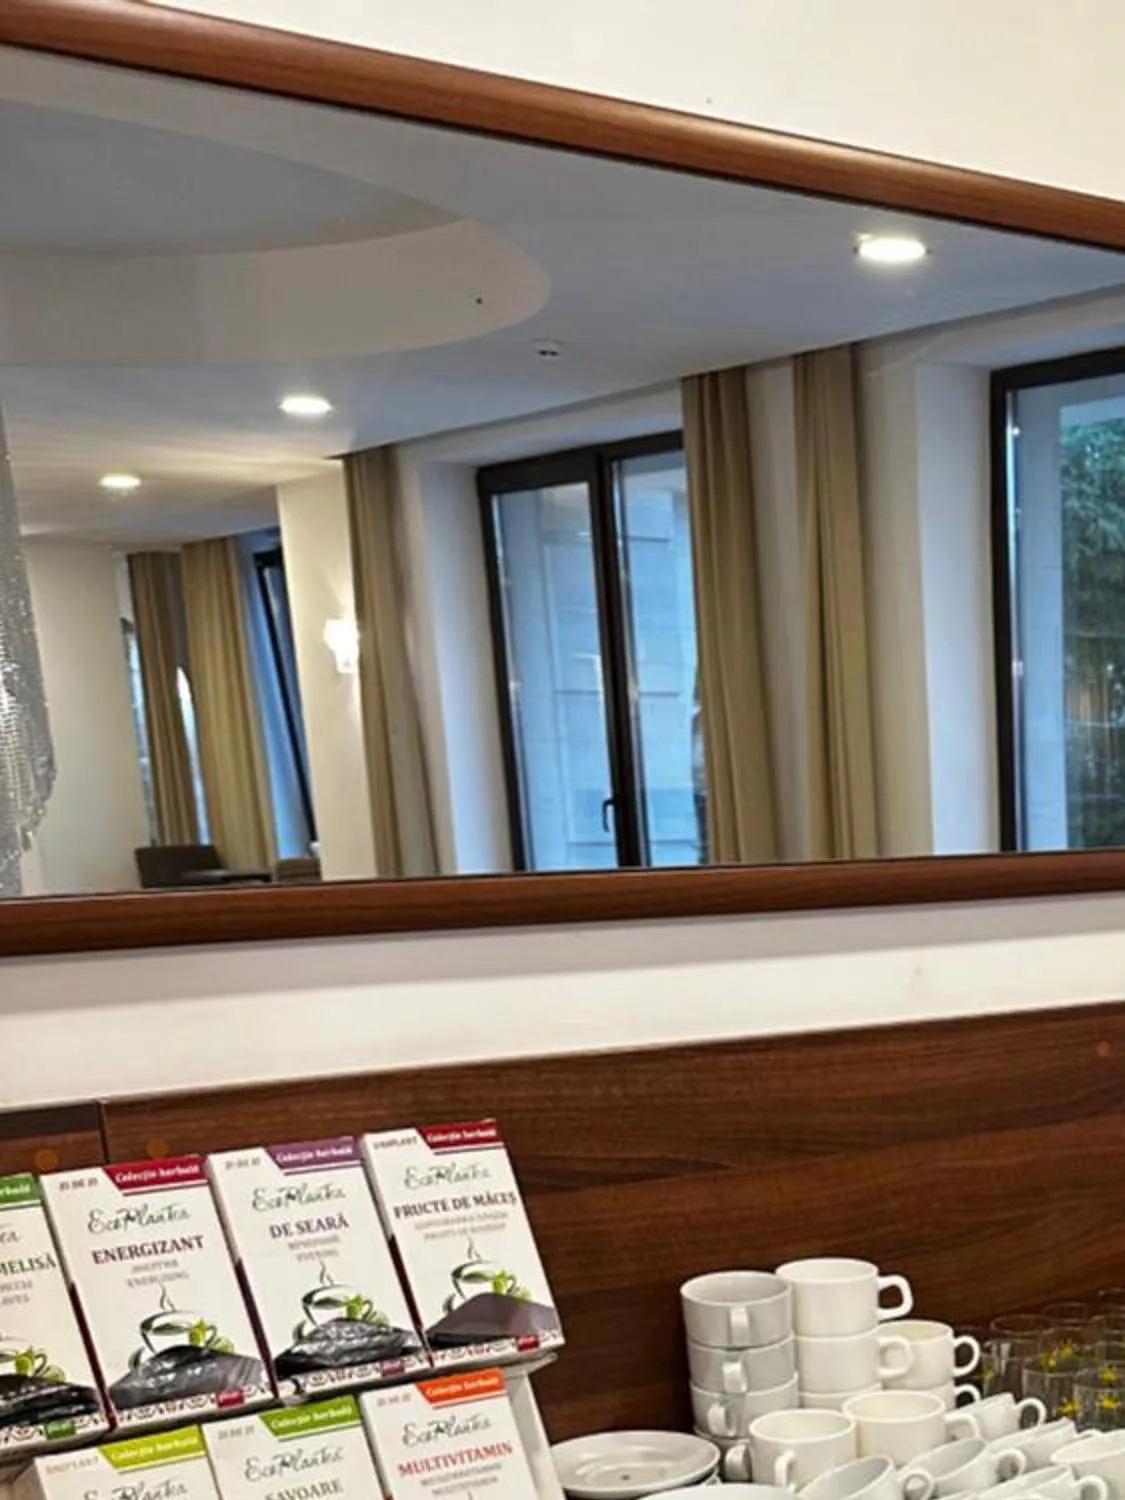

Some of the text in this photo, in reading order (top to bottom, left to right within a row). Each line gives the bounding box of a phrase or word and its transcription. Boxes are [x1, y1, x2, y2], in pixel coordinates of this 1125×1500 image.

[394, 1199, 450, 1219] FRUCTE
[452, 1195, 472, 1211] DE
[269, 1213, 349, 1239] DE SEARĂ
[93, 1235, 204, 1264] ENERGIZANT
[397, 1441, 514, 1476] MULTIVITAMIN
